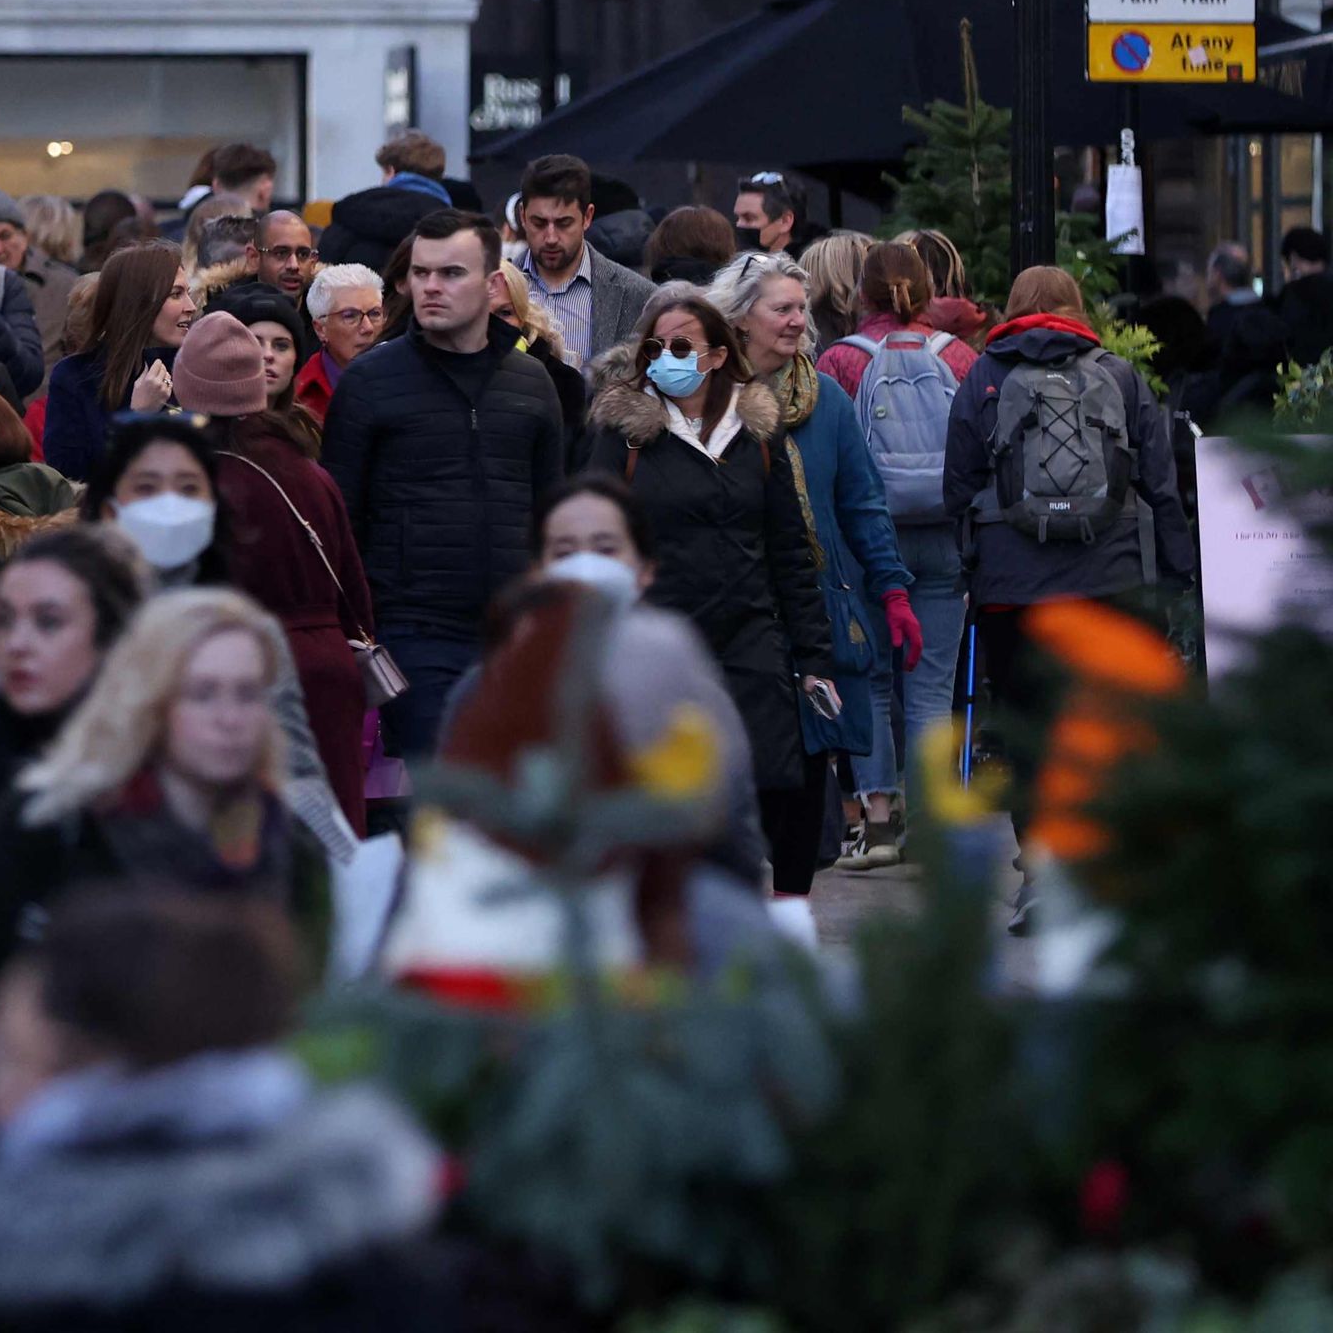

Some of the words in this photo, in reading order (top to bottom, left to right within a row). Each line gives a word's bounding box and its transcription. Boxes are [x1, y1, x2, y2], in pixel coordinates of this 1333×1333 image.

[1171, 32, 1191, 51] At
[1200, 35, 1234, 54] any
[1049, 501, 1071, 511] RUSH
